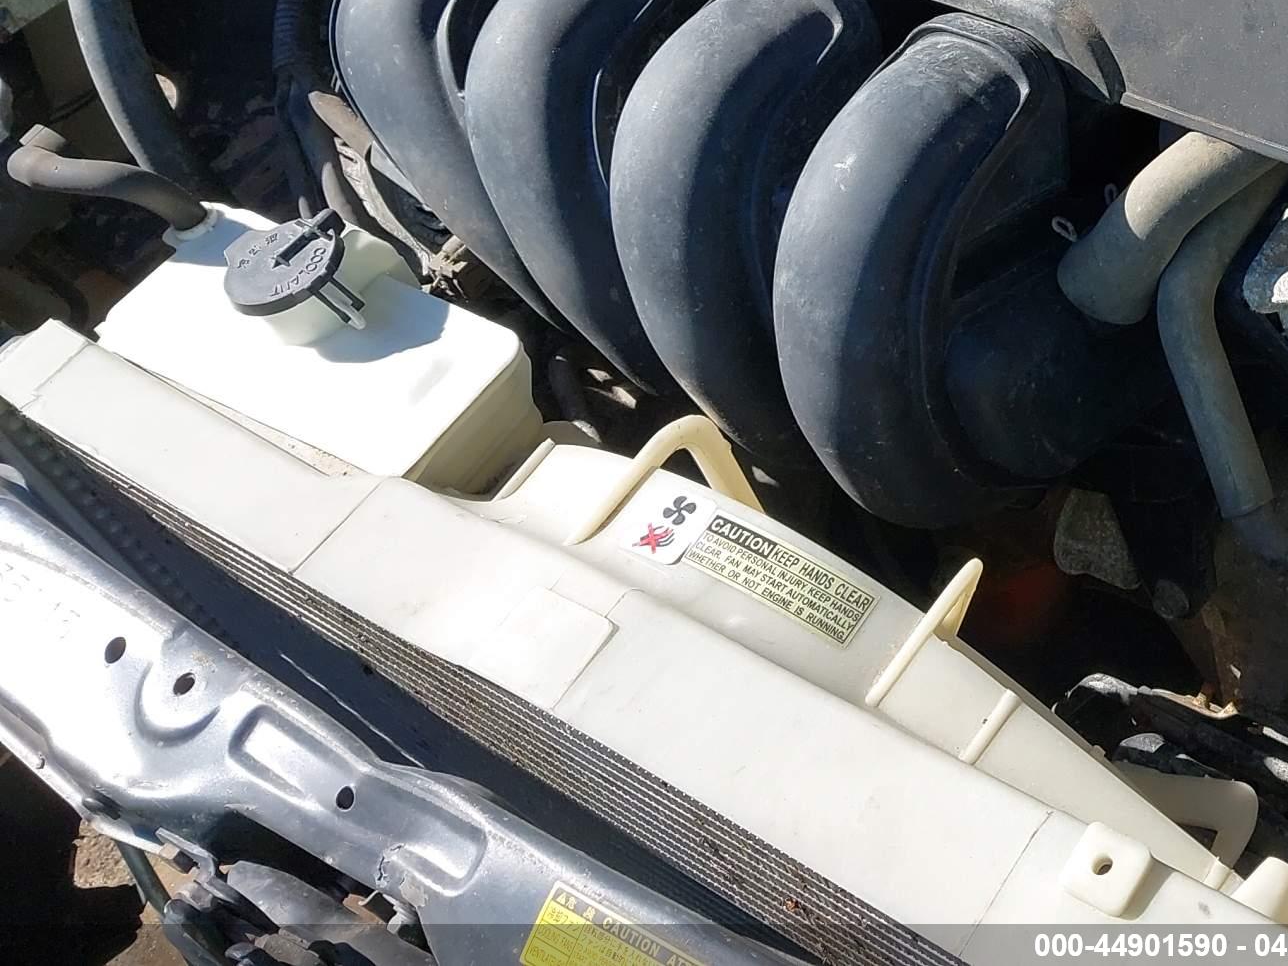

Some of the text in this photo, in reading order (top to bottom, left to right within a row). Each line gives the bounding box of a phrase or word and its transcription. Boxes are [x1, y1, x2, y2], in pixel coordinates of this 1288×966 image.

[688, 550, 726, 574] WHETHER
[728, 569, 741, 581] OR
[743, 577, 763, 591] NOT
[762, 588, 794, 610] ENGINE
[794, 605, 805, 616] IS
[702, 532, 714, 542] TO
[713, 537, 737, 554] AVOID
[737, 548, 776, 575] PERSONAL
[808, 586, 831, 604] KEEP
[831, 599, 860, 622] HANDS
[711, 518, 870, 612] CAUTION KEEP HANDS CLEAR
[725, 555, 742, 569] FAN
[743, 564, 762, 579] MAY
[761, 573, 786, 593] START
[786, 587, 855, 631] AUTOMATICALLY
[602, 916, 661, 957] CAUTION
